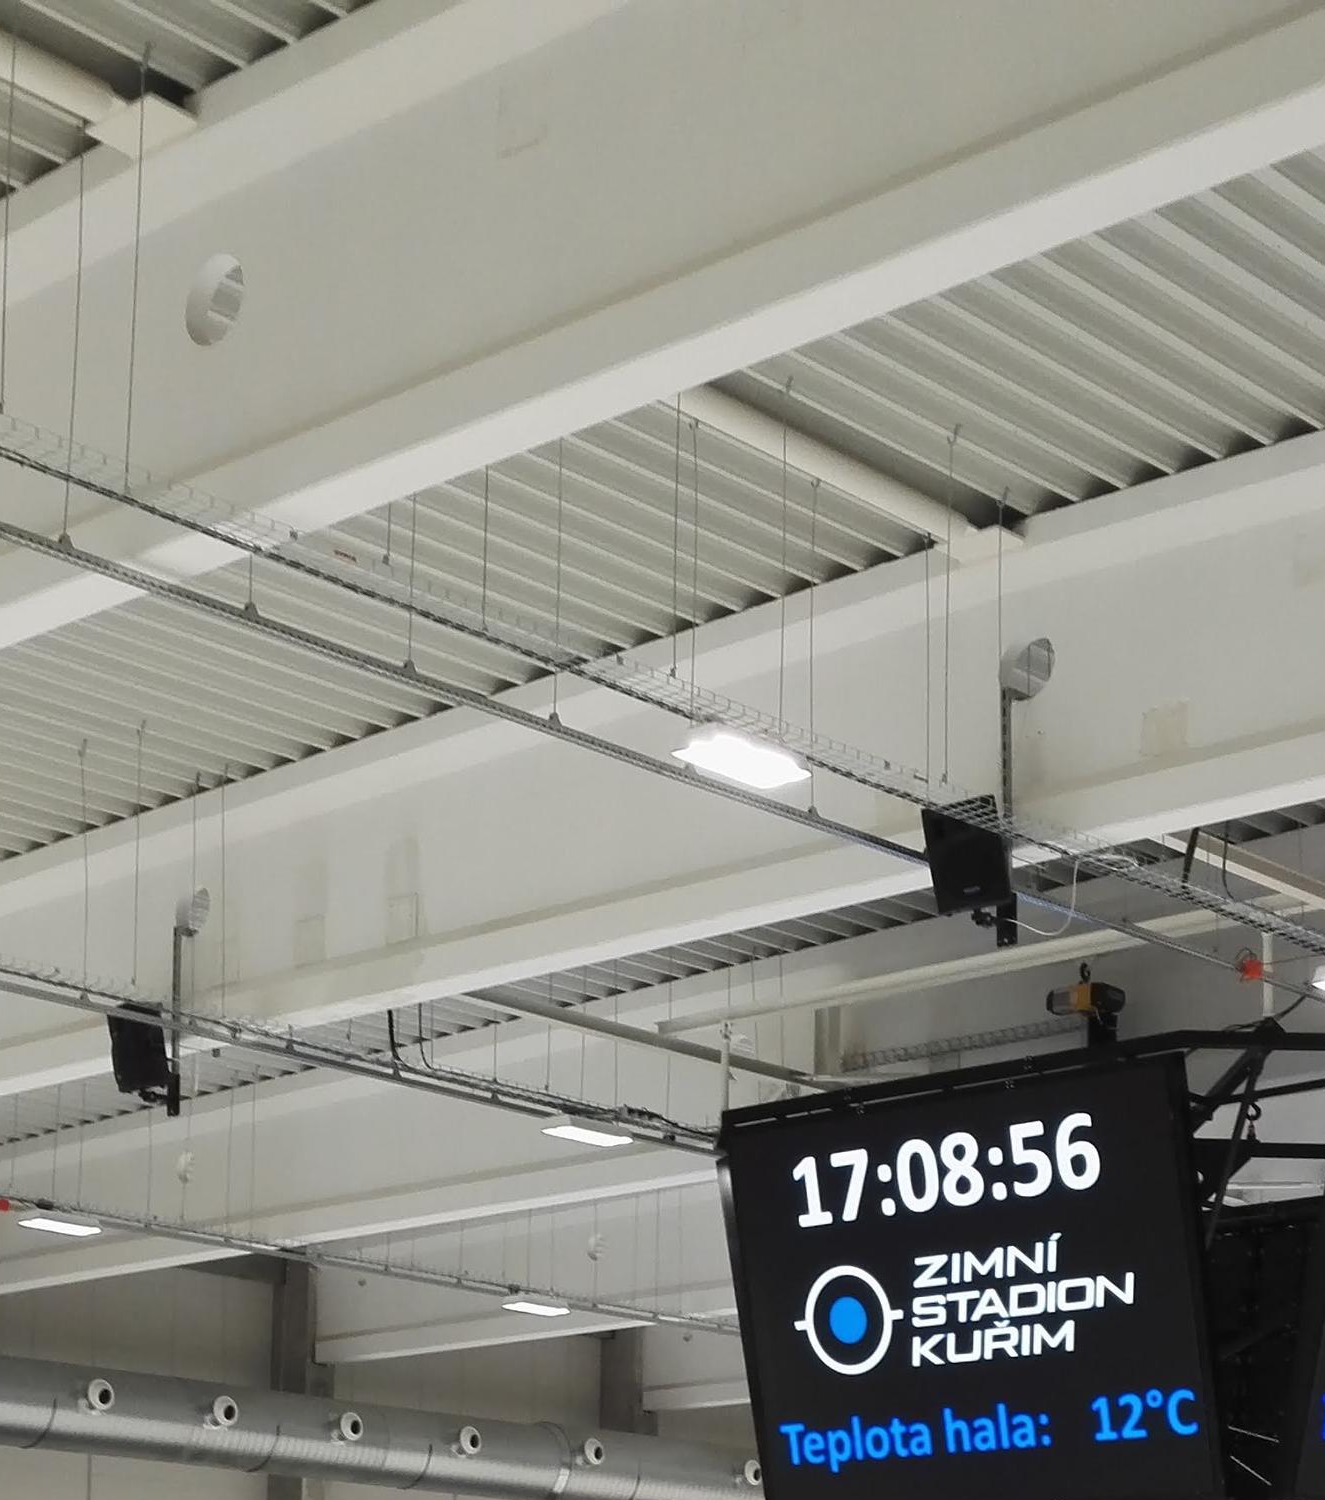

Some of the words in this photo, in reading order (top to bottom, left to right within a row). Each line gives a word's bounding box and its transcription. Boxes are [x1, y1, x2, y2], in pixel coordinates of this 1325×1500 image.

[792, 1112, 1100, 1228] 17:08:56
[913, 1232, 1062, 1288] ZIMNÍ
[912, 1272, 1134, 1328] STADION
[912, 1320, 1075, 1367] KUŘIM
[779, 1415, 933, 1474] Teplota
[943, 1403, 1052, 1453] hala:
[1091, 1389, 1199, 1441] 12°C
